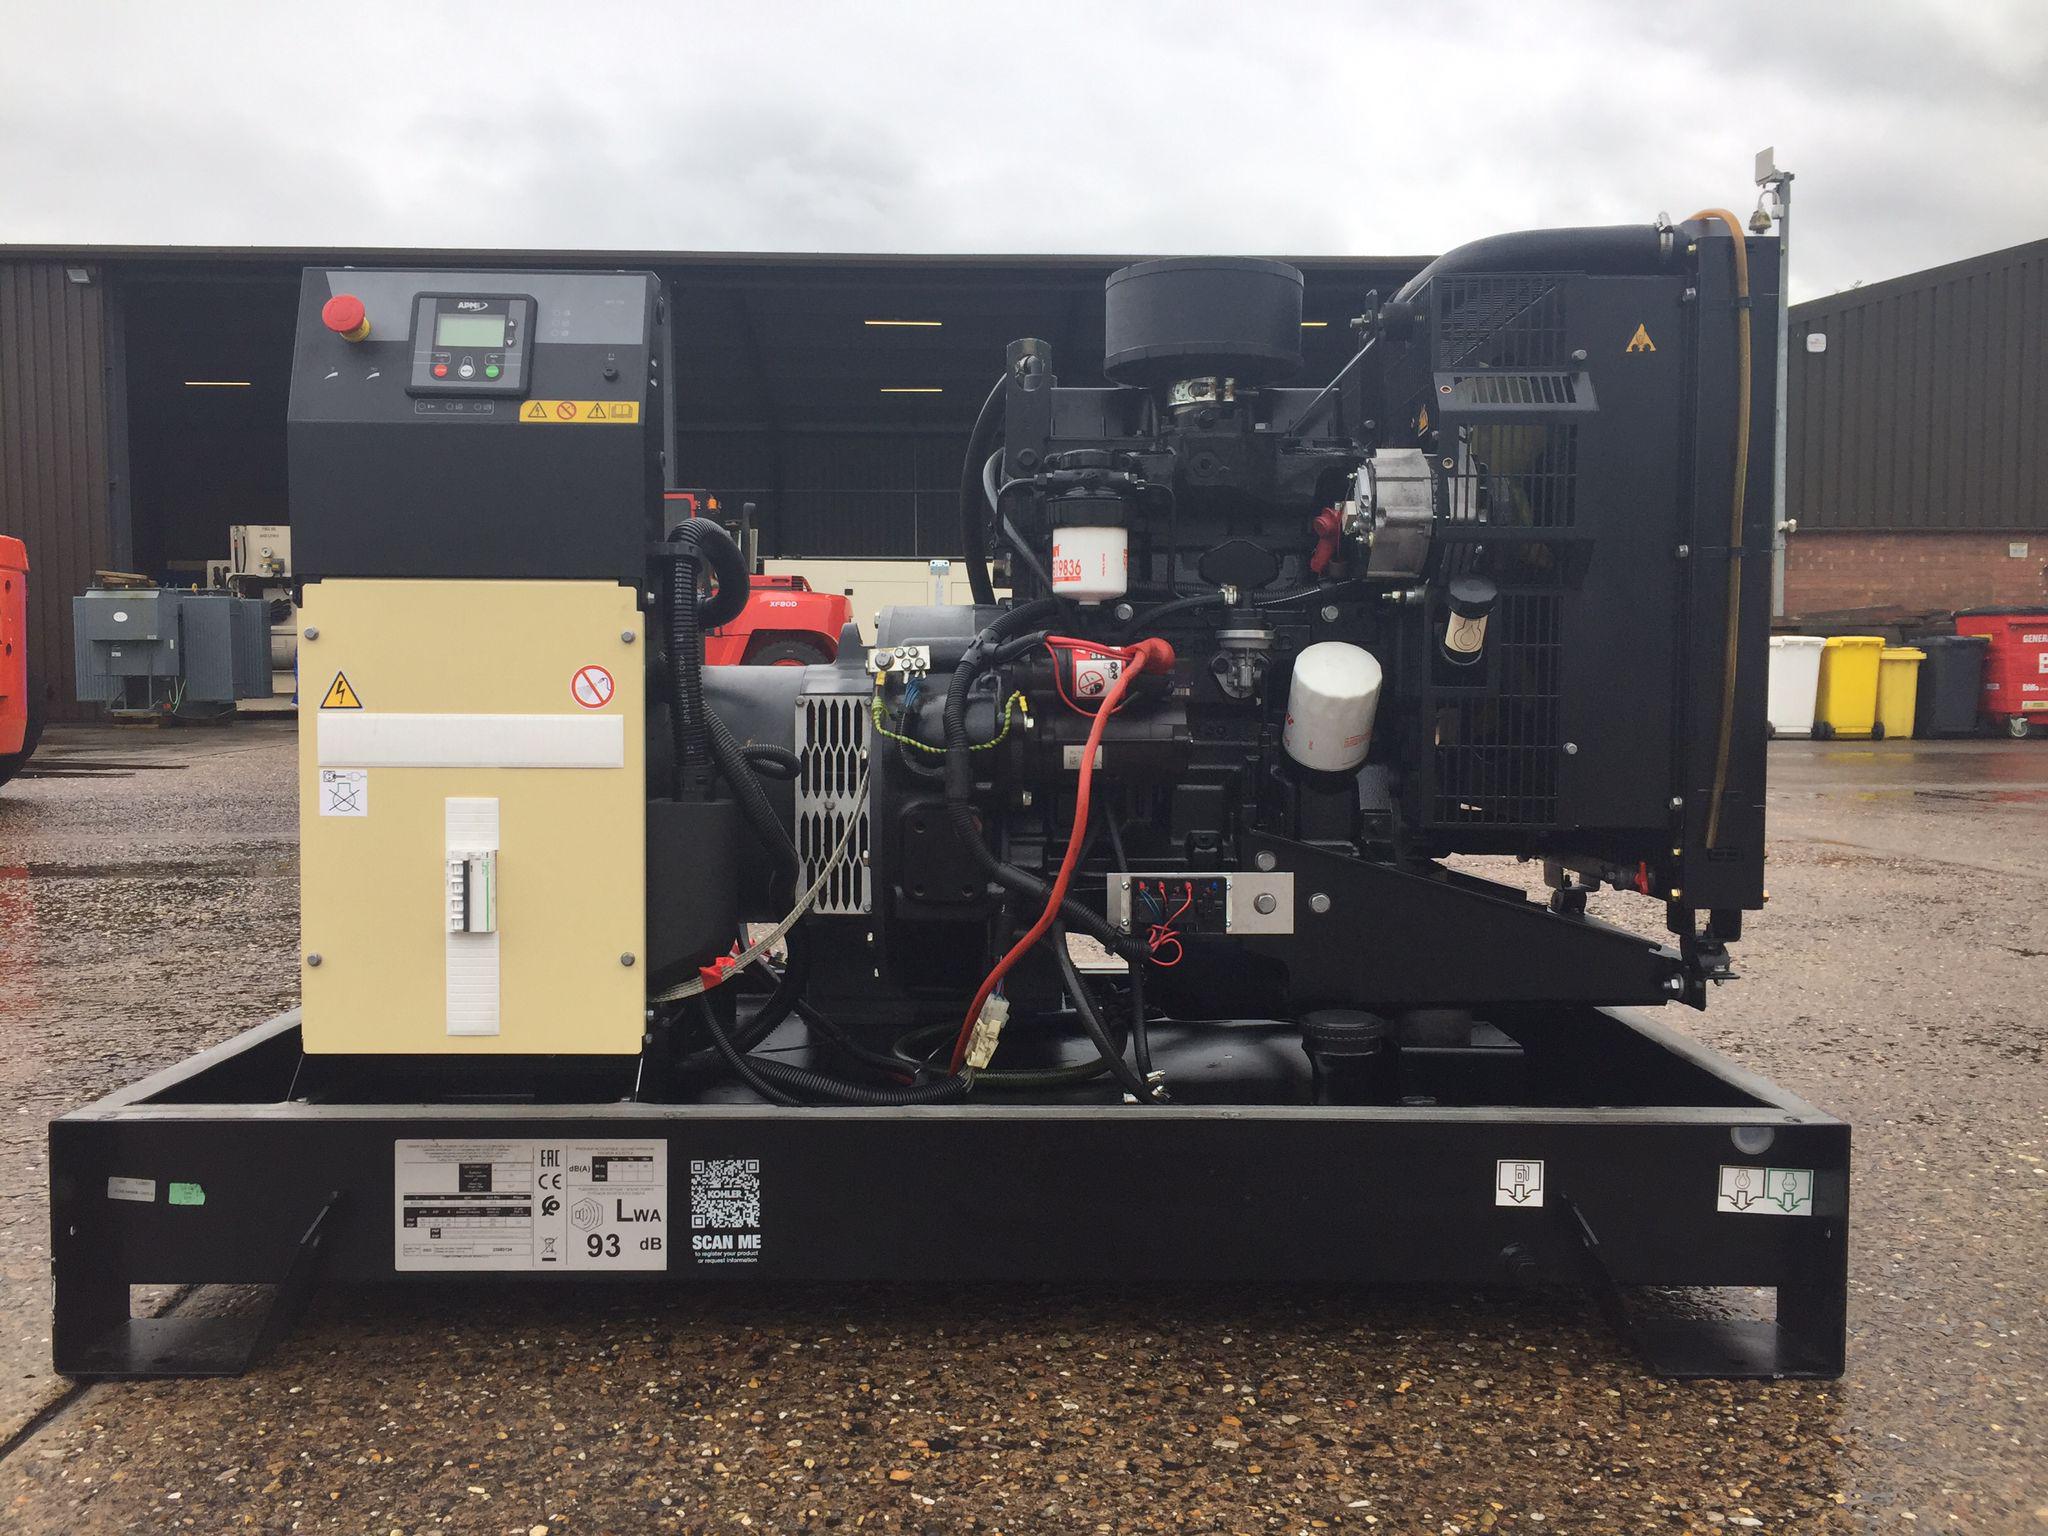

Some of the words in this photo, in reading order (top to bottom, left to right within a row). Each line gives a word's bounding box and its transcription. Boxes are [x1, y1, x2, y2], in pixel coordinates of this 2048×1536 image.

[568, 1165, 591, 1173] dB(A)
[707, 1189, 742, 1199] KOHLER
[586, 1233, 621, 1258] 93
[639, 1237, 662, 1251] dB
[692, 1234, 733, 1250] SCAN
[737, 1234, 762, 1249] ME
